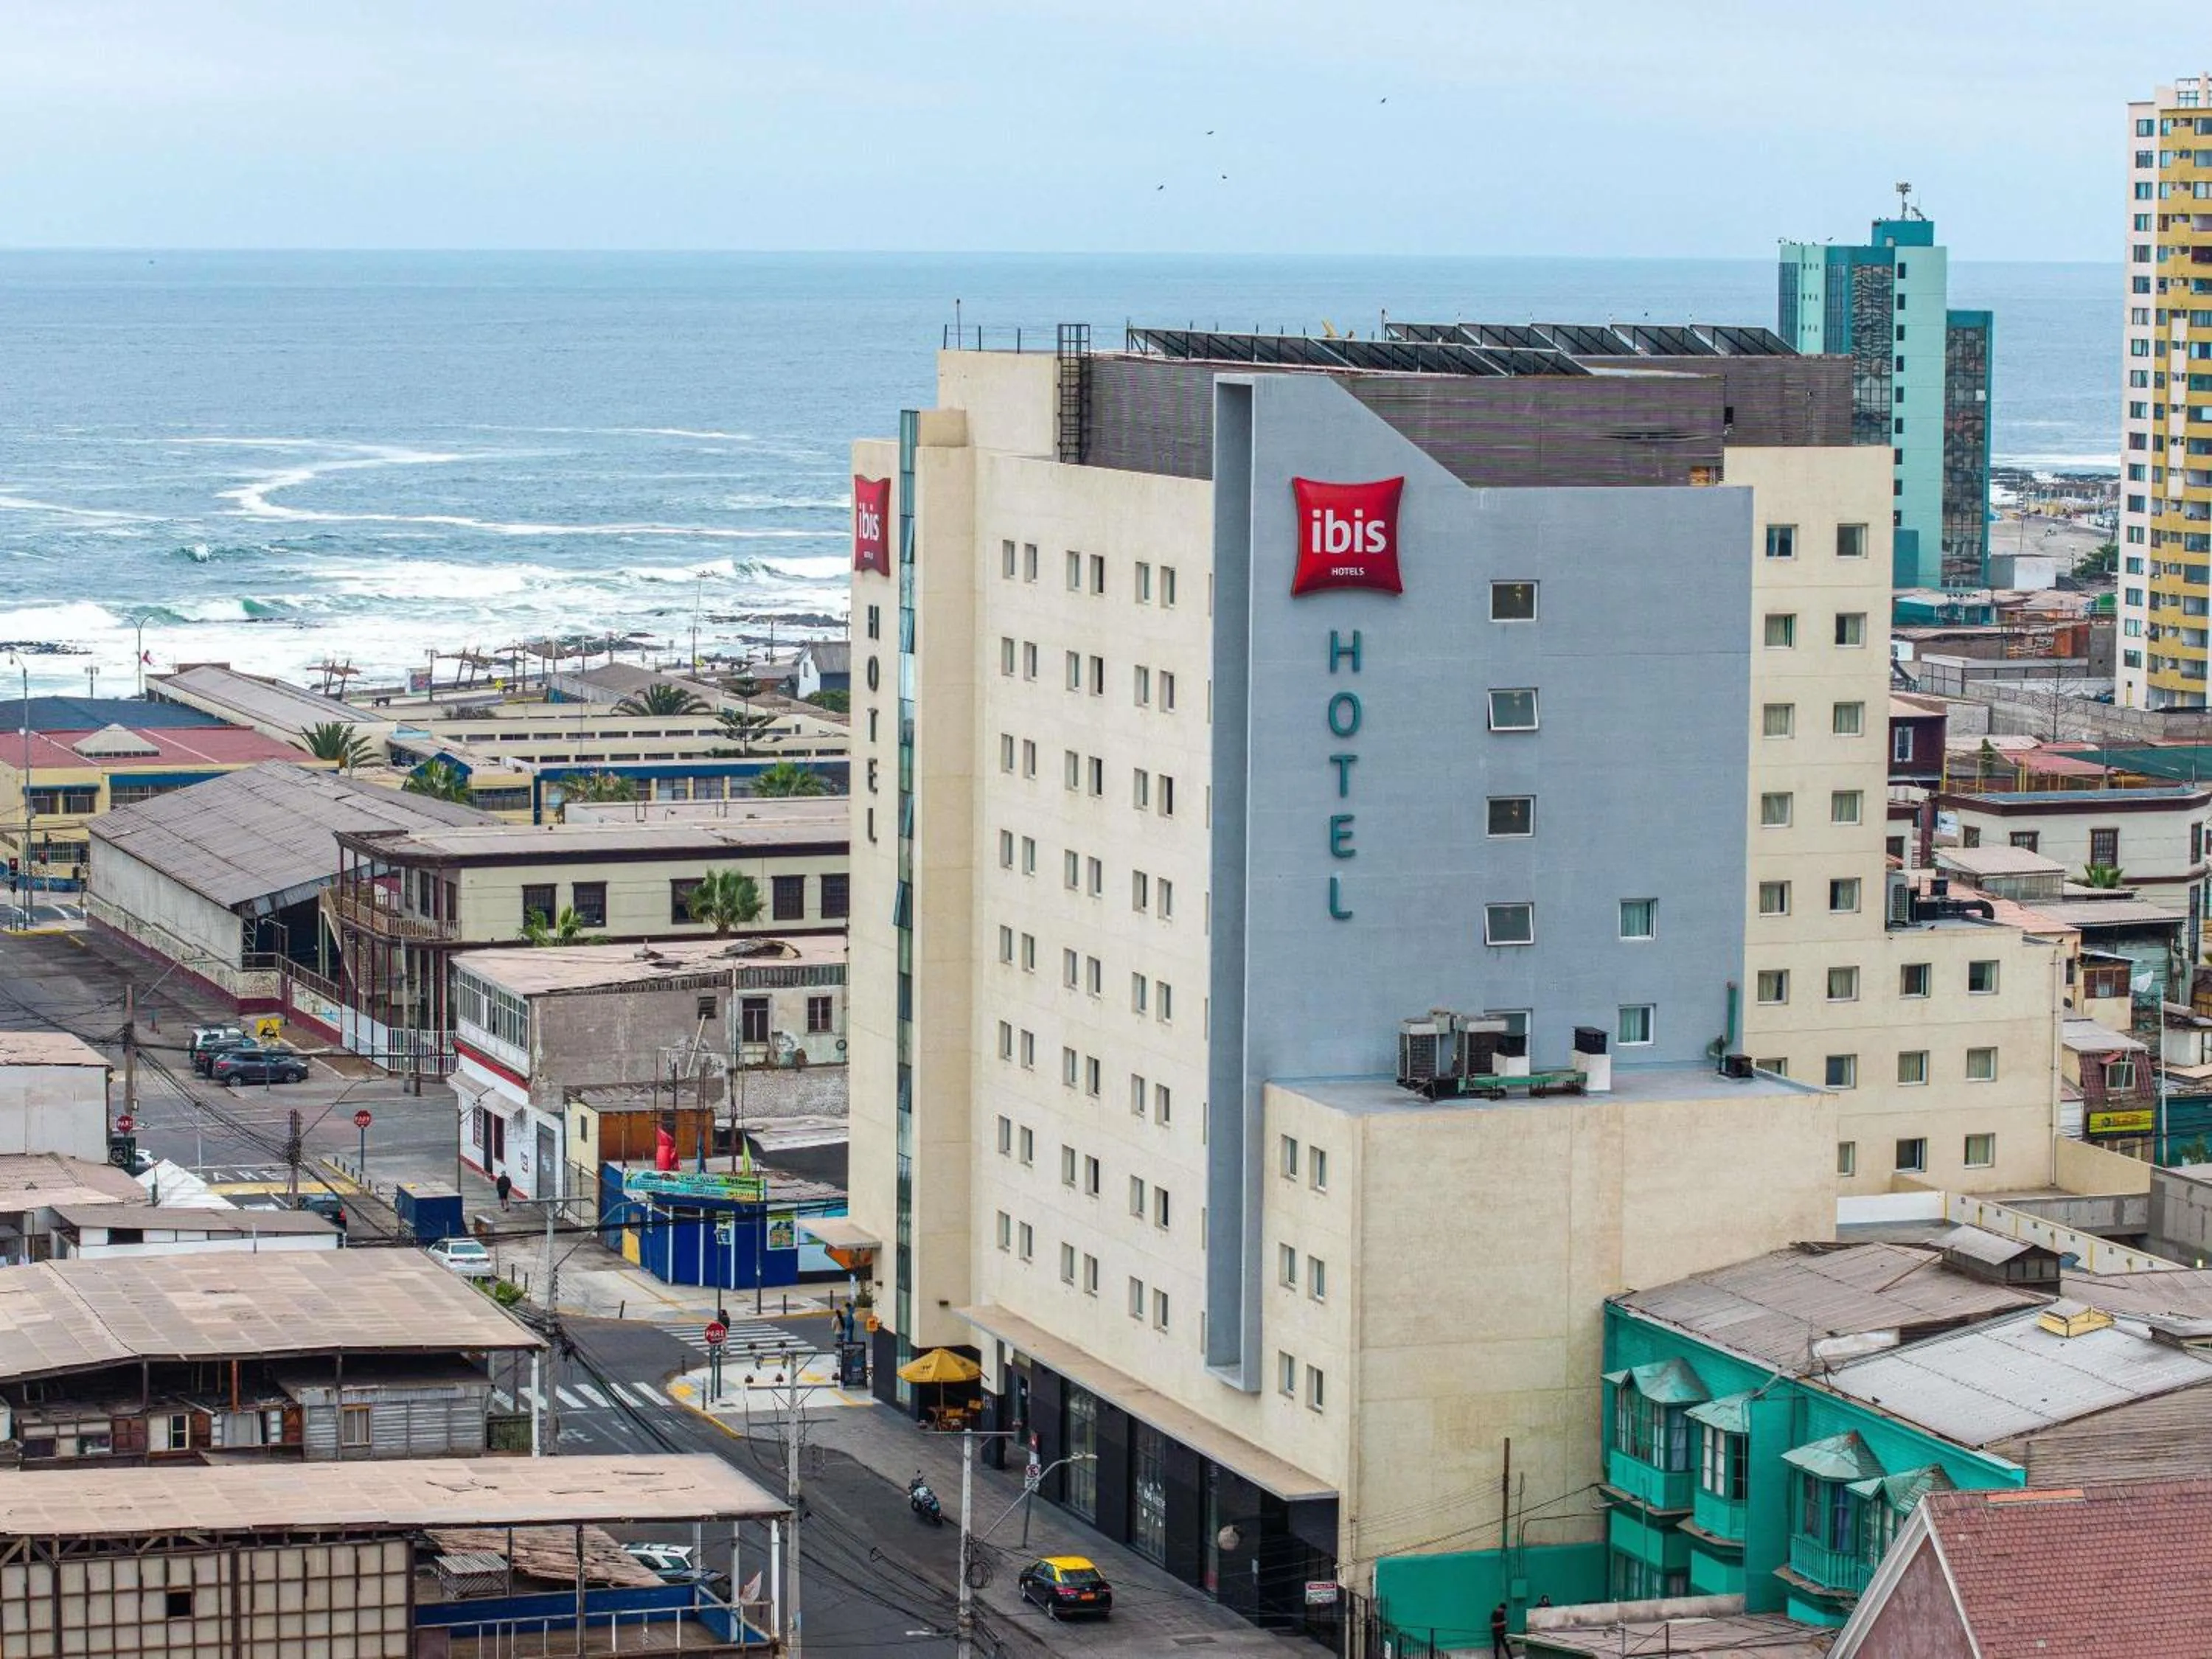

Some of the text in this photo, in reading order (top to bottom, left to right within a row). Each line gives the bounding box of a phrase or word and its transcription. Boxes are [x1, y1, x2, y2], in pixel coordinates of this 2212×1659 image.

[858, 501, 880, 541] ibis
[1312, 509, 1387, 553] ibis
[1332, 567, 1364, 576] HOTELS
[867, 605, 880, 844] HOTEL
[1328, 629, 1362, 920] HOTEL
